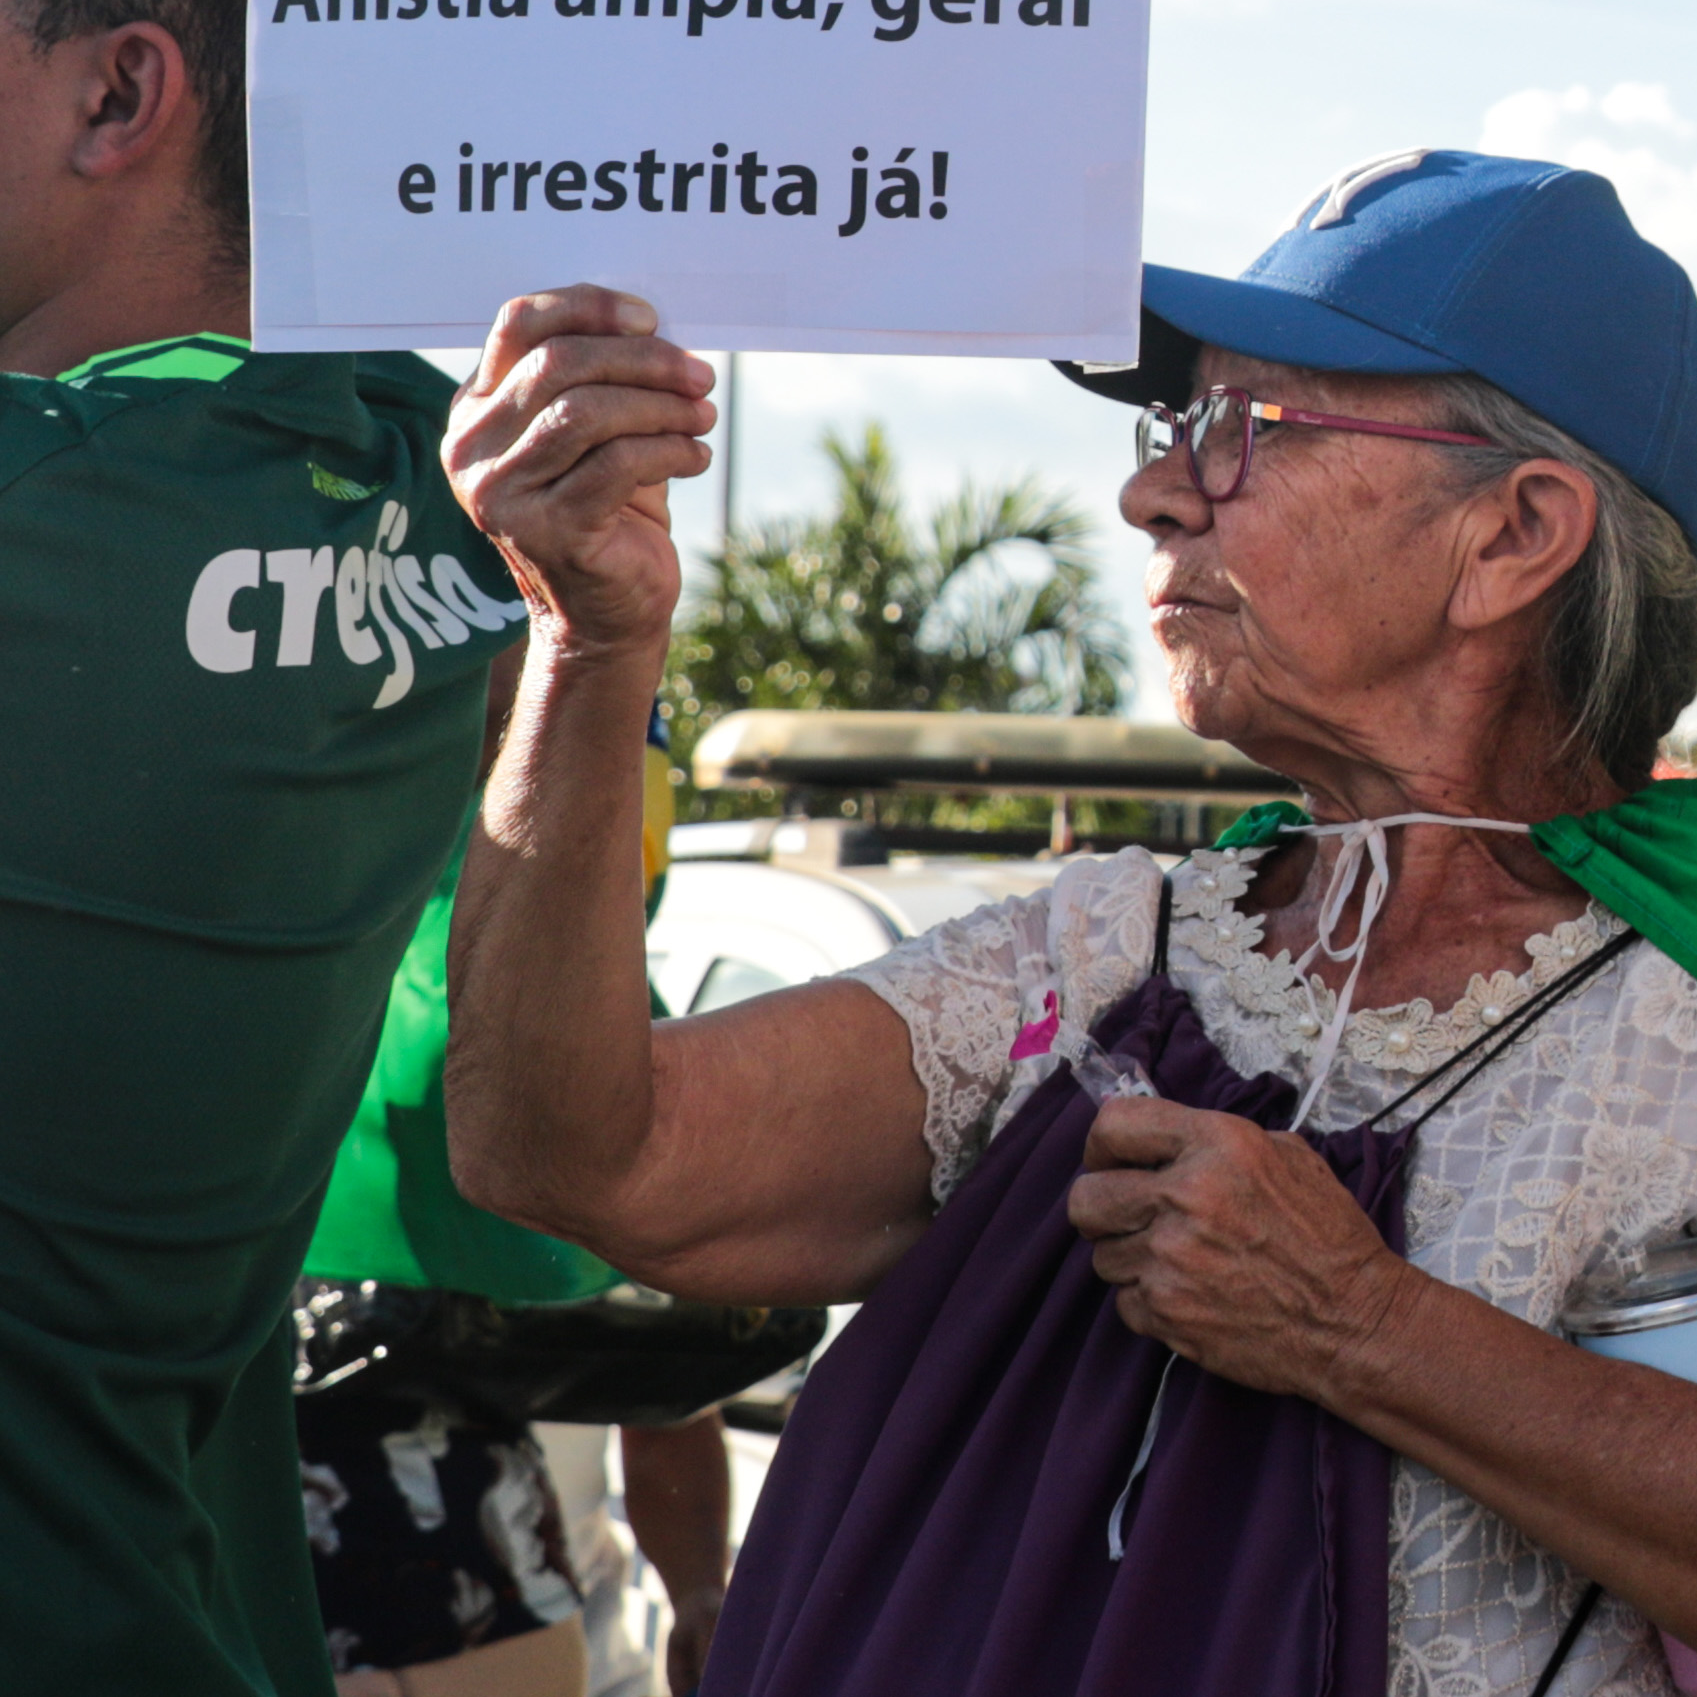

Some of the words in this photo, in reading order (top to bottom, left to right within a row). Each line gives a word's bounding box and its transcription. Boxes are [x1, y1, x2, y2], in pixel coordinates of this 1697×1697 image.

[397, 162, 436, 215] e
[458, 141, 818, 217] irrestrita
[837, 146, 950, 238] já!
[186, 500, 529, 709] crefisa
